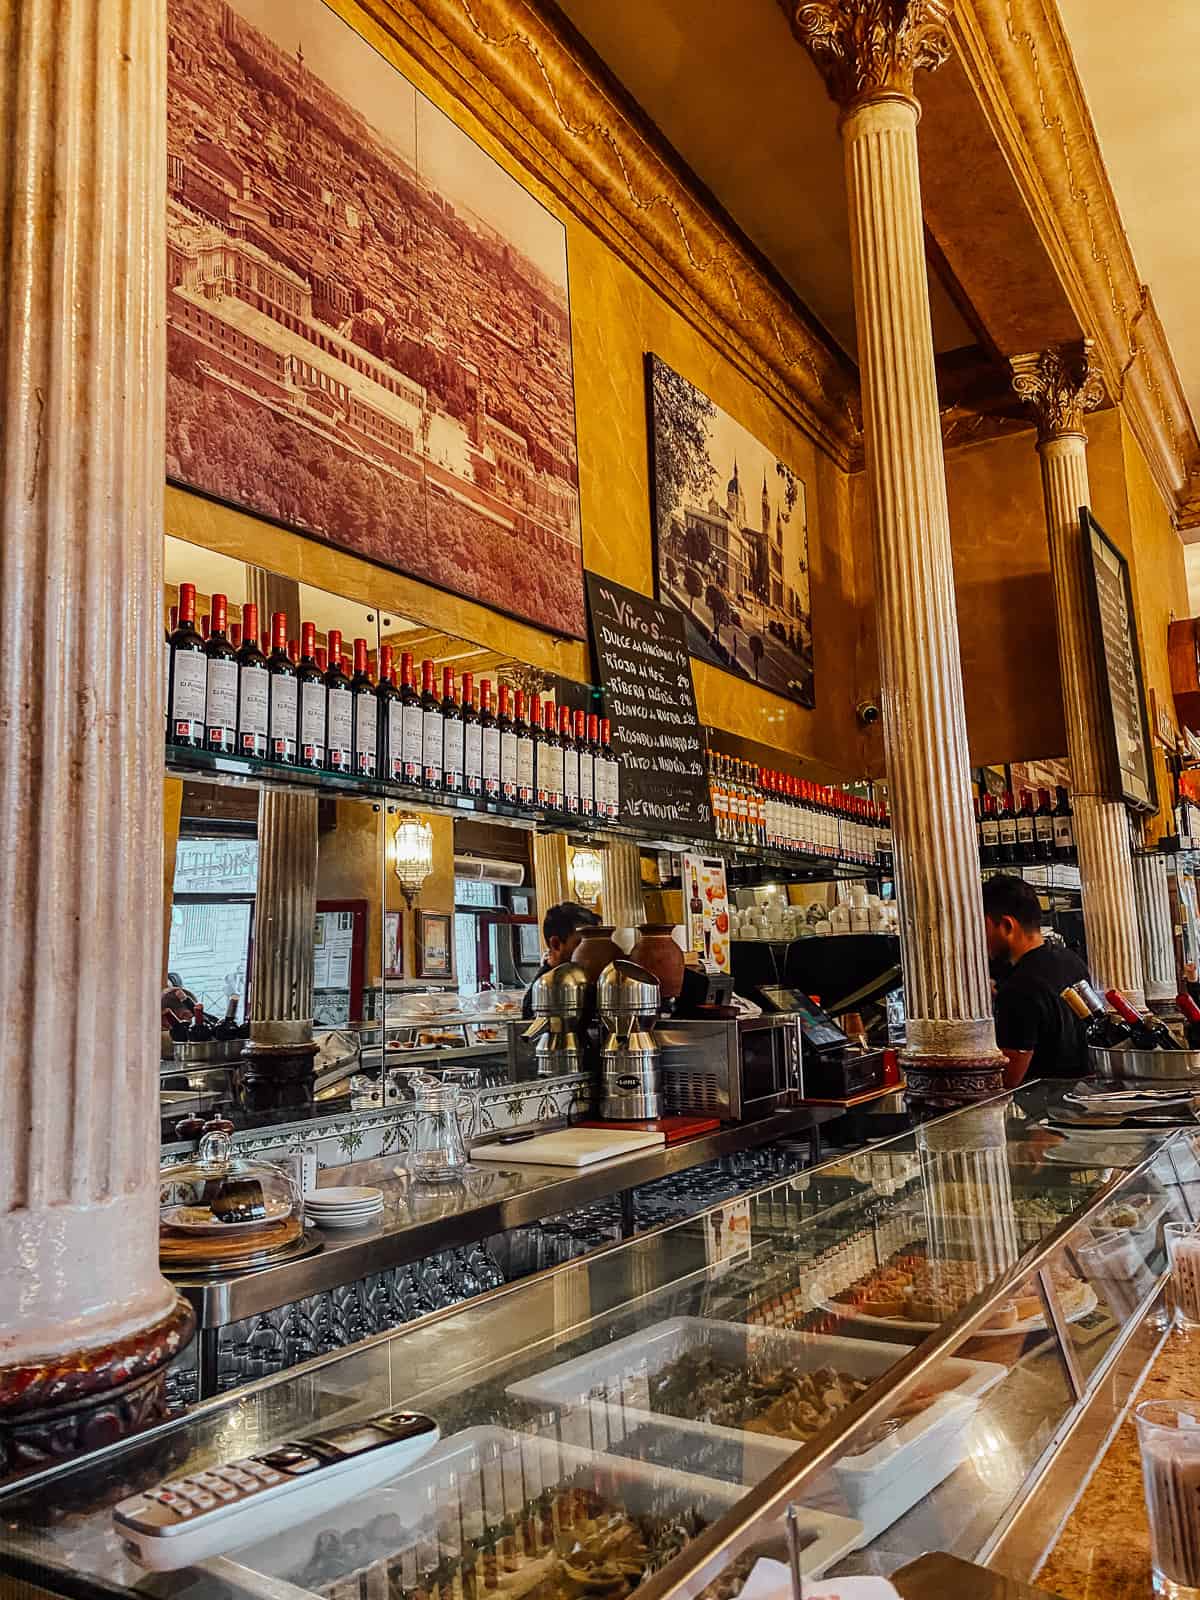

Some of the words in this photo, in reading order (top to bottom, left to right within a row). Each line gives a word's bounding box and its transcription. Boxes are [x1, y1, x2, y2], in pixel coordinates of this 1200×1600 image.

[604, 652, 637, 675] RIOJA
[610, 676, 645, 700] RIBERA
[613, 700, 648, 719] BLANCO
[618, 726, 654, 748] ROSADO
[621, 750, 650, 770] TINTO
[626, 798, 679, 821] VERMOUTH
